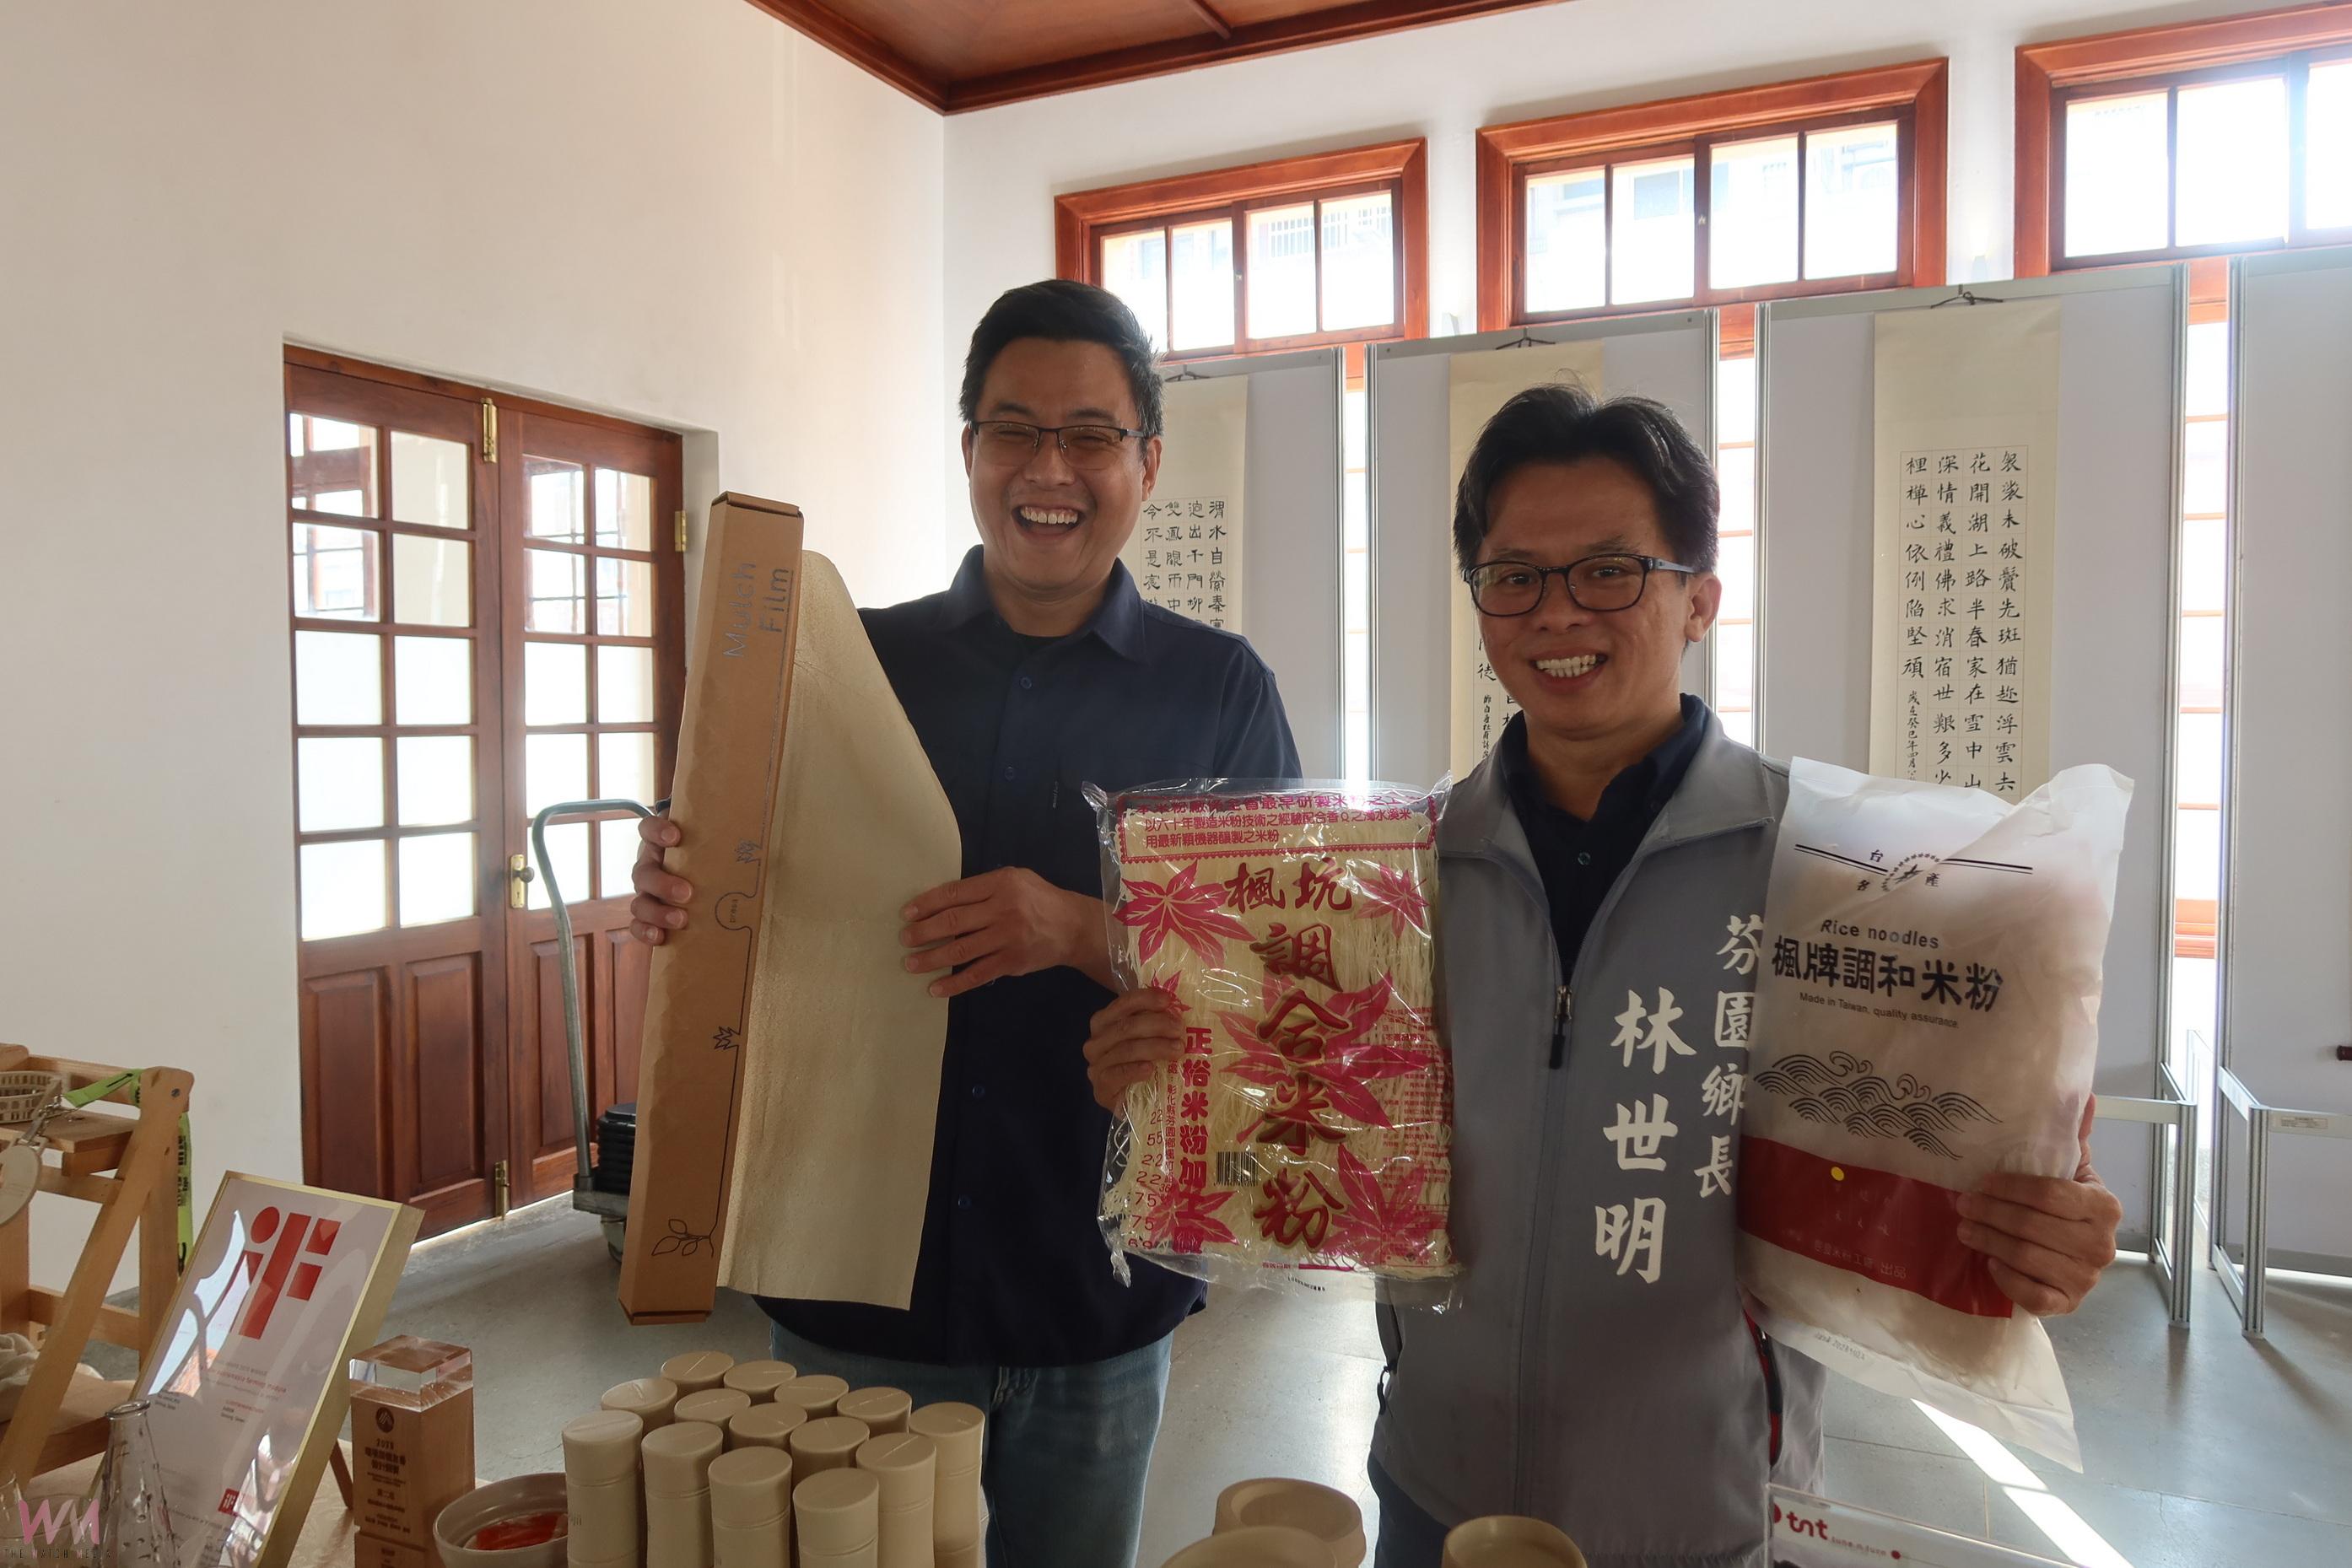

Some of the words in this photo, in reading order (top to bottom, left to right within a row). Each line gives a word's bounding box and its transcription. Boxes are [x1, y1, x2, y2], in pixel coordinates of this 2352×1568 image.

[723, 562, 755, 659] Mulch
[760, 568, 789, 633] Film
[1869, 849, 1884, 863] 台
[1225, 861, 1353, 913] 楓坑
[1821, 919, 1859, 938] Rice
[1868, 926, 1939, 950] noodles
[1772, 935, 2004, 1012] 楓牌調和米粉
[1799, 992, 1825, 1005] Made
[1826, 996, 1836, 1006] in
[1873, 1006, 1908, 1022] quality
[1694, 913, 1763, 1199] 芬園鄉長
[1249, 922, 1352, 1252] 調合米粉
[1594, 986, 1697, 1284] 林世明
[1880, 1261, 1907, 1280] 出品
[1786, 1511, 1828, 1540] tnt
